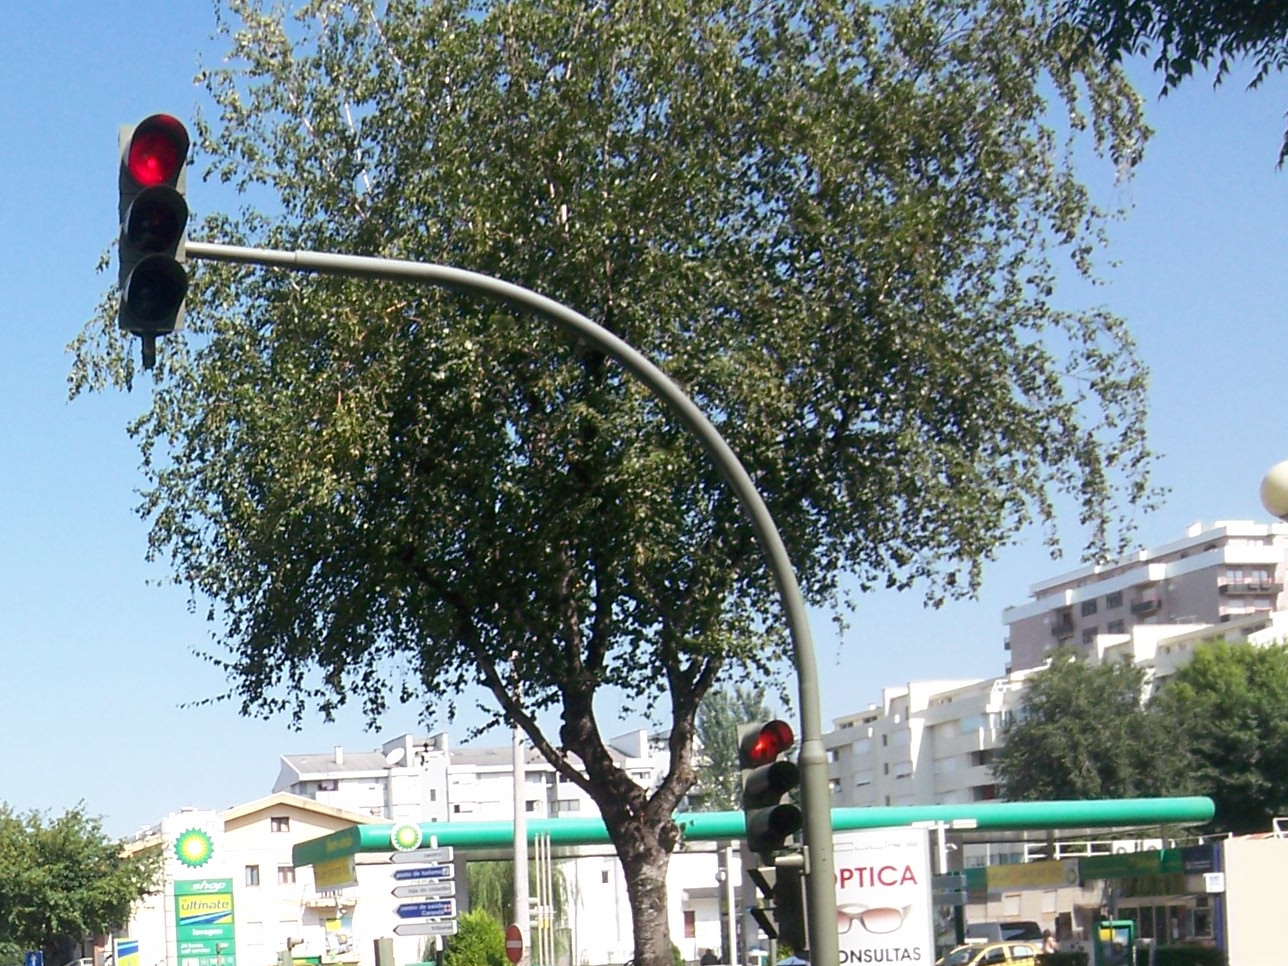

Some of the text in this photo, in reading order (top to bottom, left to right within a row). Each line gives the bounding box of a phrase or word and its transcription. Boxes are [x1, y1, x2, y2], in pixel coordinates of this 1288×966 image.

[833, 864, 918, 889] PTICA
[192, 879, 227, 892] shop
[181, 899, 230, 911] ultimate
[839, 947, 921, 964] ONSULTAS
